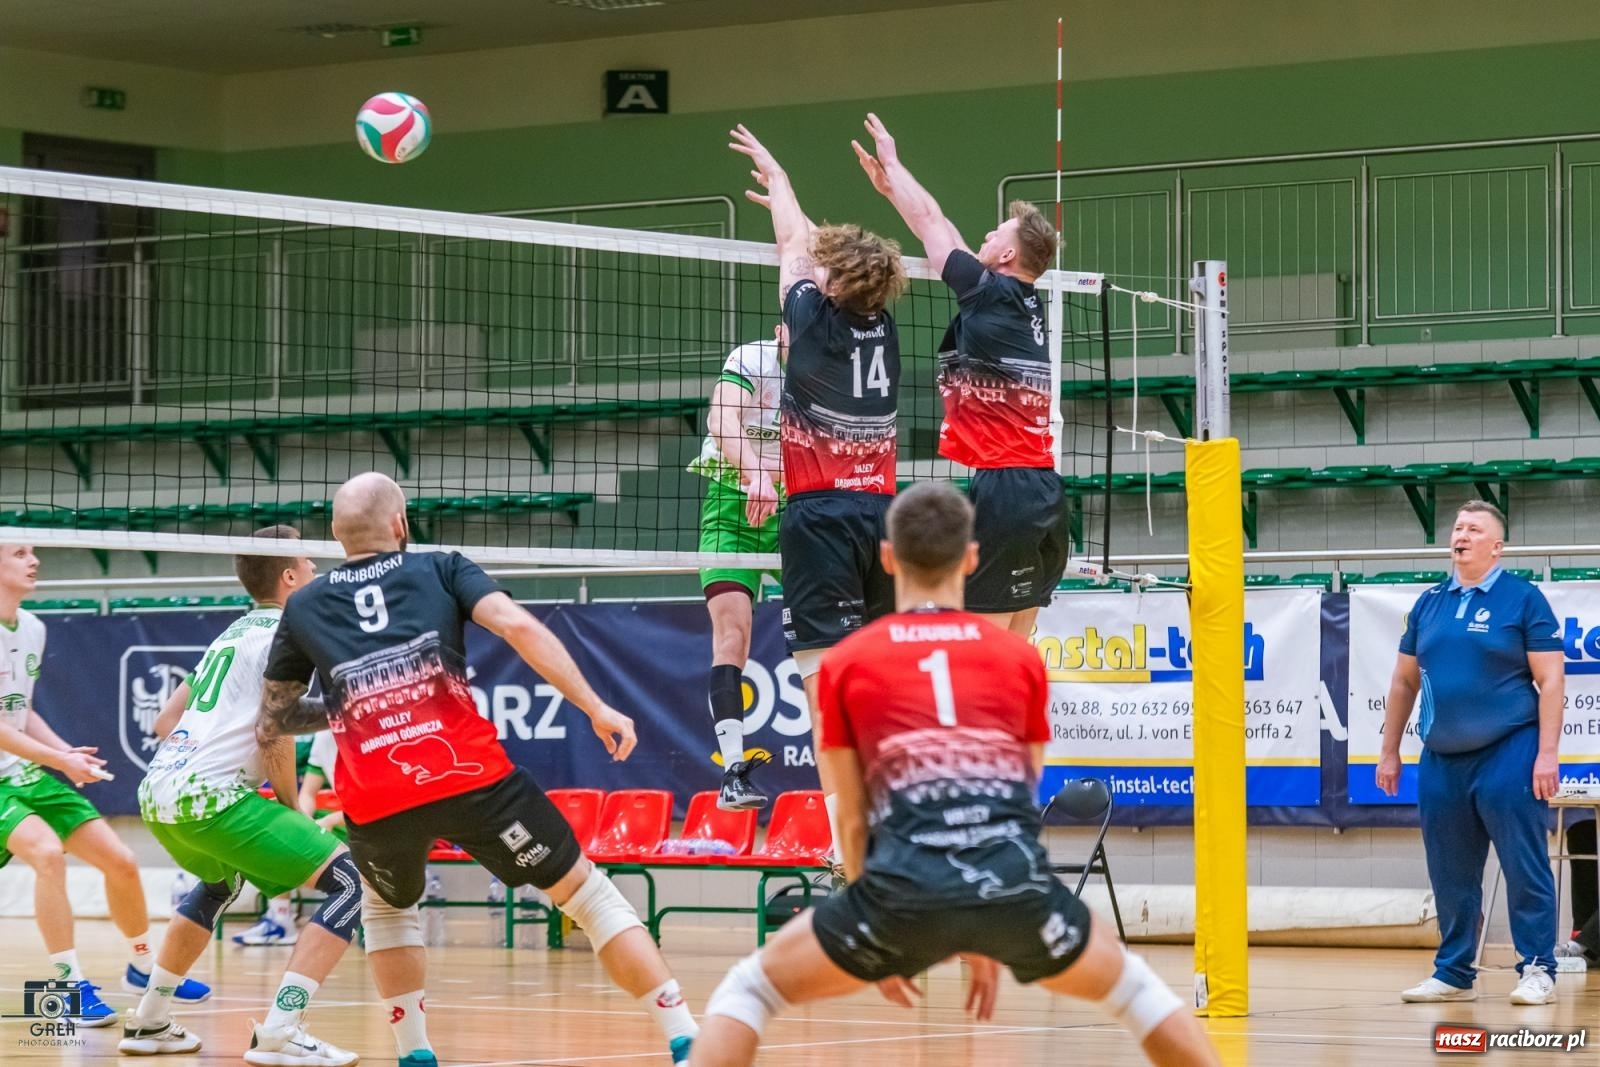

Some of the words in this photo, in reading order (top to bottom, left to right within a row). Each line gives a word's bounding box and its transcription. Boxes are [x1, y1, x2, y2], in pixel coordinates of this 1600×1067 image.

[616, 85, 658, 109] A
[850, 345, 890, 398] 14
[329, 553, 403, 585] RACIBORSKI
[354, 584, 389, 633] 9
[918, 649, 958, 727] 1
[379, 711, 412, 730] VOLLEY
[1061, 701, 1077, 716] 92
[1110, 701, 1137, 716] 502
[1141, 701, 1168, 716] 632
[1172, 700, 1194, 716] 69
[1276, 699, 1303, 715] 647
[360, 731, 401, 755] DĄBROWA
[400, 719, 444, 740] GÓRNICZA
[1053, 723, 1113, 741] Racibórz,
[1117, 724, 1133, 739] ul.
[1138, 724, 1147, 739] J.
[1152, 728, 1178, 739] von
[1284, 724, 1293, 739] 2
